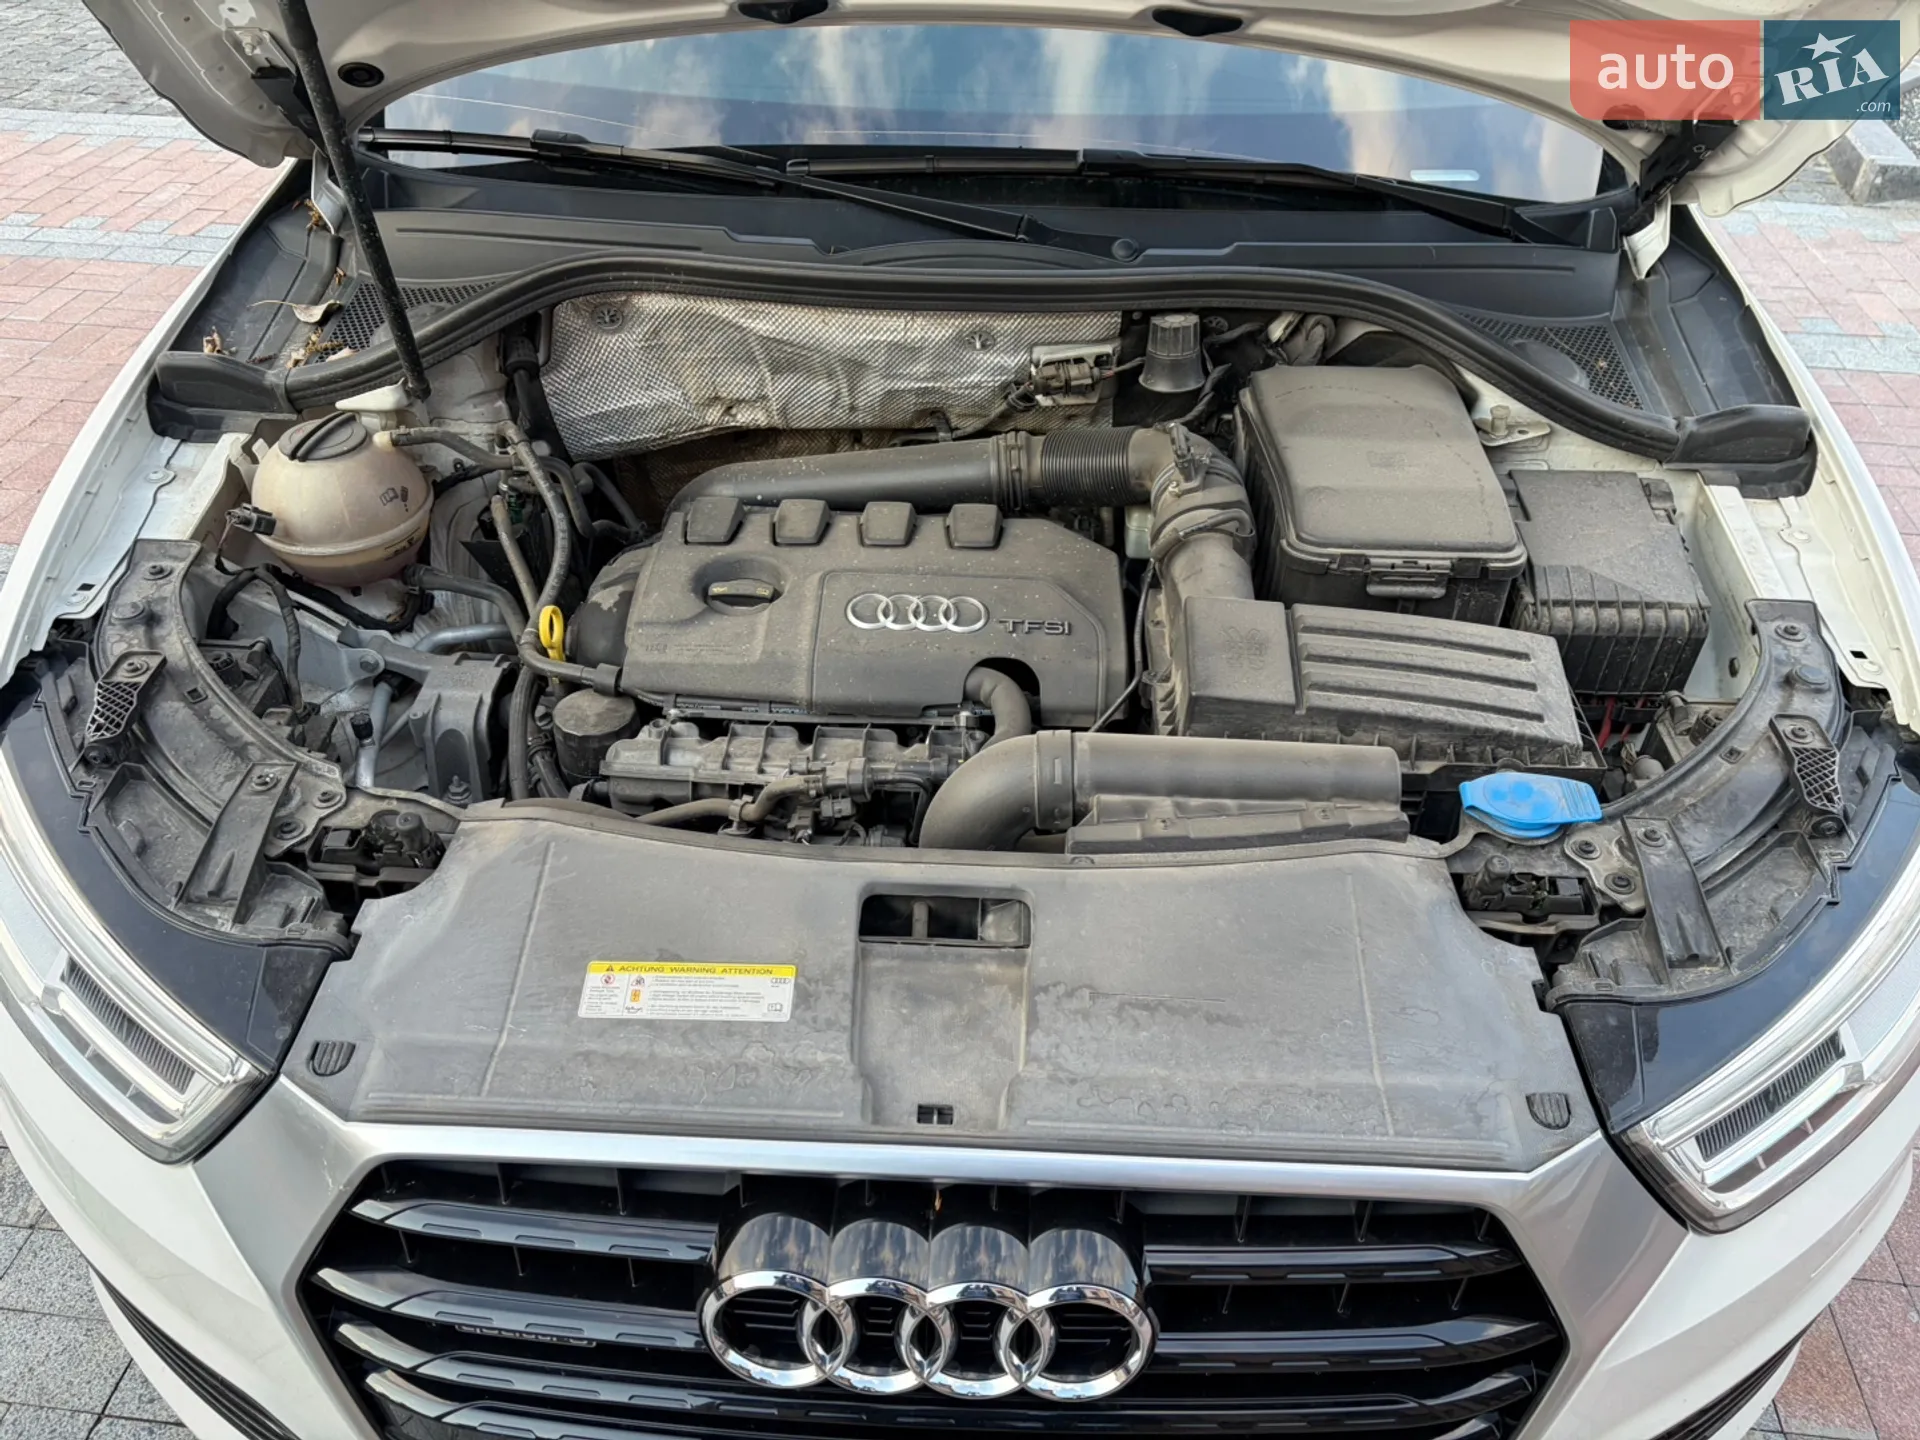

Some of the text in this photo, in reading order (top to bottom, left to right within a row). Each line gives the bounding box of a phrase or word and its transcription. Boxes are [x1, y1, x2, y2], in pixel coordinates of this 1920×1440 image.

[999, 618, 1072, 636] TFSI
[618, 965, 774, 976] ACHTUNG WARNING ATTENTION
